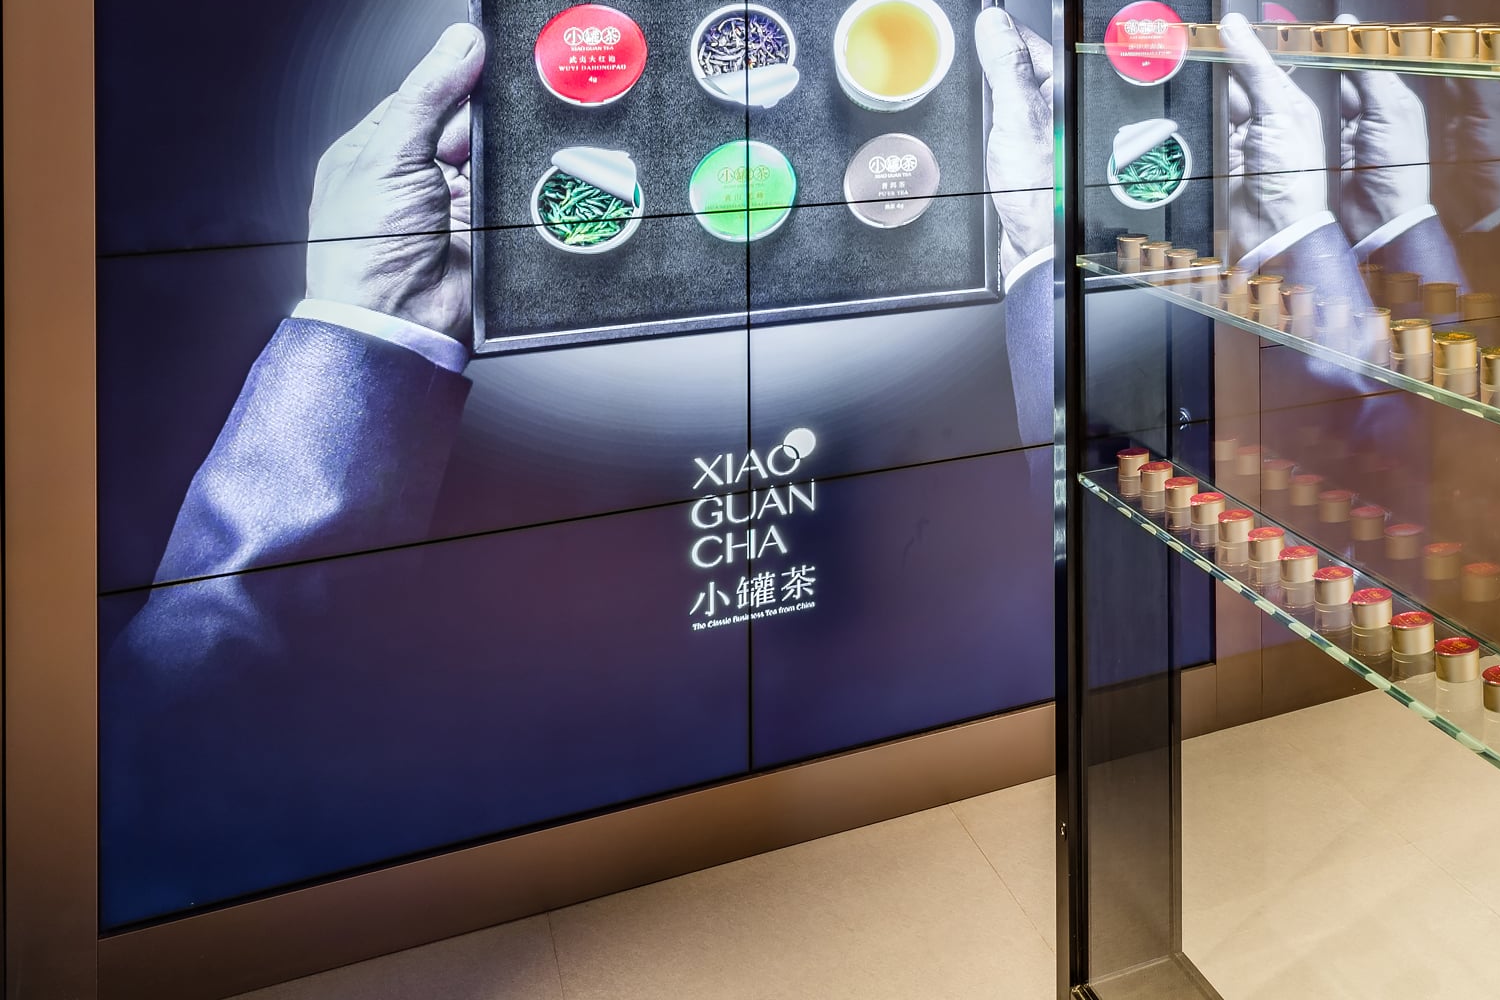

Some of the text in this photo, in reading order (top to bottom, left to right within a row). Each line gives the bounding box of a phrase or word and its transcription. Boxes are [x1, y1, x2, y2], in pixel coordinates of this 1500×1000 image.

[692, 444, 800, 490] XIAO
[691, 478, 816, 529] GUAN
[691, 525, 788, 568] CHA
[690, 565, 816, 617] 小罐茶
[778, 604, 795, 615] from
[796, 601, 816, 612] China
